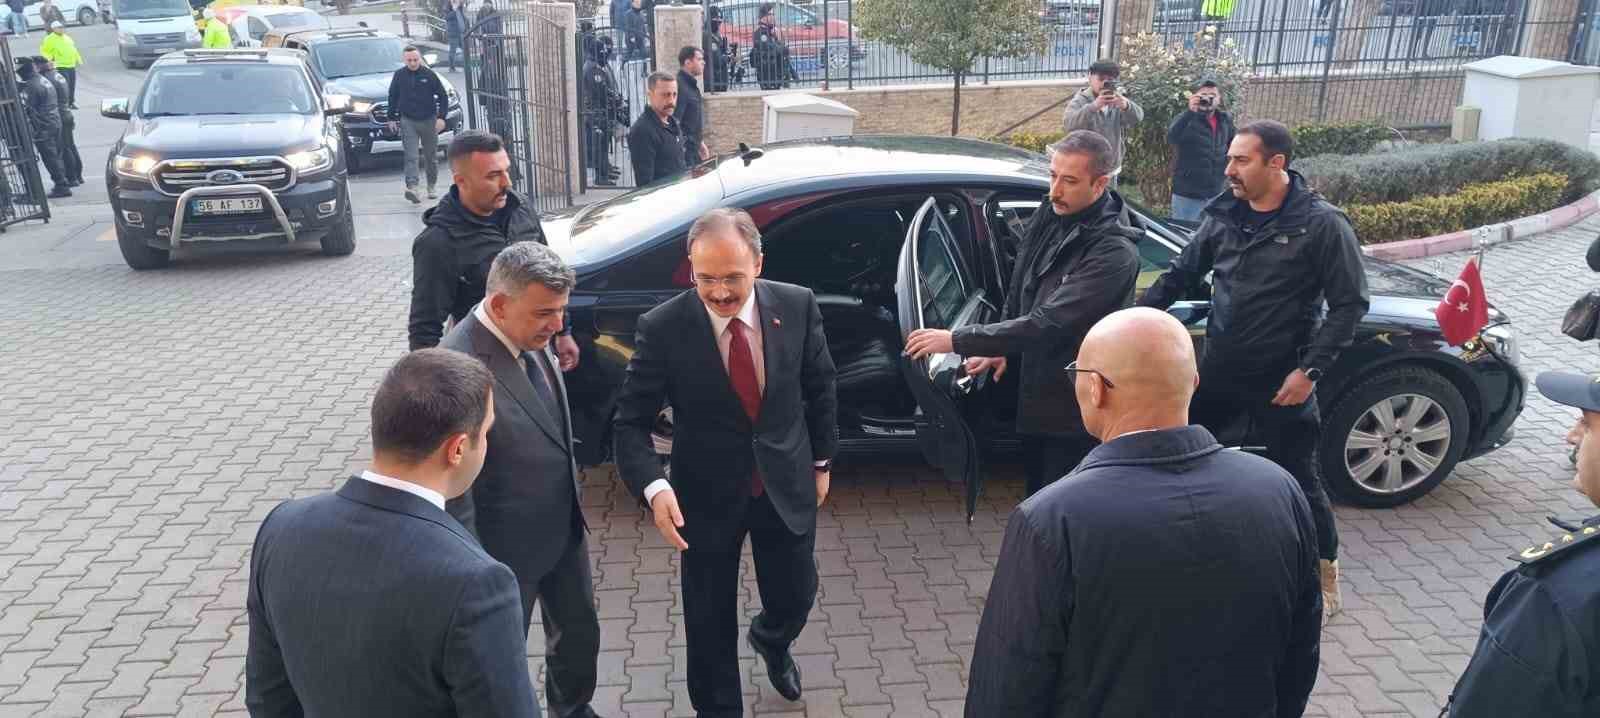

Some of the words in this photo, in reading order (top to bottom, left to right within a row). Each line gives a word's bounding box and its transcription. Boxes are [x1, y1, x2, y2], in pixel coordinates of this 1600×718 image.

[199, 201, 213, 210] 56
[220, 200, 233, 210] AF
[240, 199, 261, 209] 137
